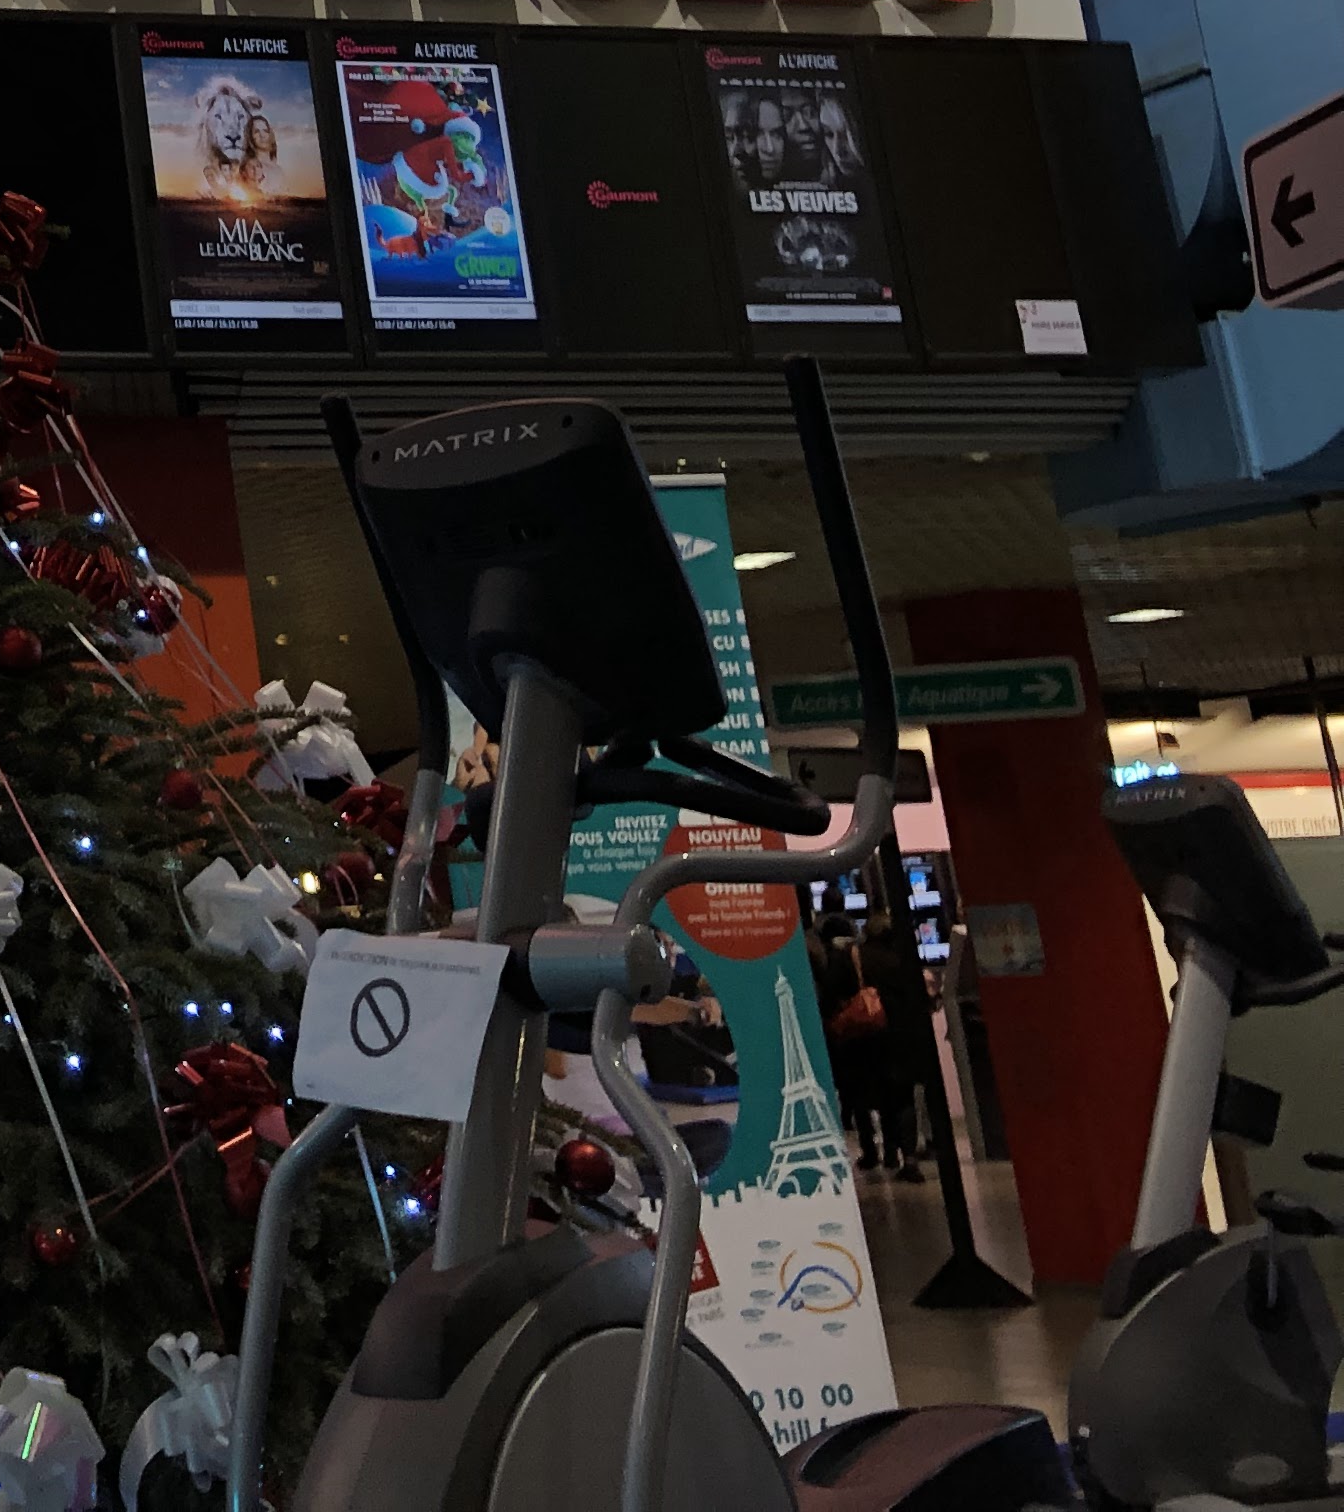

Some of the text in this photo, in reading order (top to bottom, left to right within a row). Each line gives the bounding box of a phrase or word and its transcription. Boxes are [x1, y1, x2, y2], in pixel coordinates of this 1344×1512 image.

[147, 37, 206, 50] Gaumont
[223, 37, 289, 54] A L'AFFICHE
[415, 43, 480, 59] A L'AFFICHE
[778, 53, 839, 71] A L'AFFICHE
[593, 188, 660, 203] Gaumont
[749, 189, 859, 213] LES VEUVES
[217, 216, 270, 245] MIA
[198, 241, 306, 263] LE LION BLANC
[394, 421, 540, 463] MATRIX
[614, 814, 669, 830] INVITEZ
[606, 829, 662, 844] VOULEZ
[688, 828, 763, 845] NOUVEAU
[775, 1383, 854, 1410] 10 00
